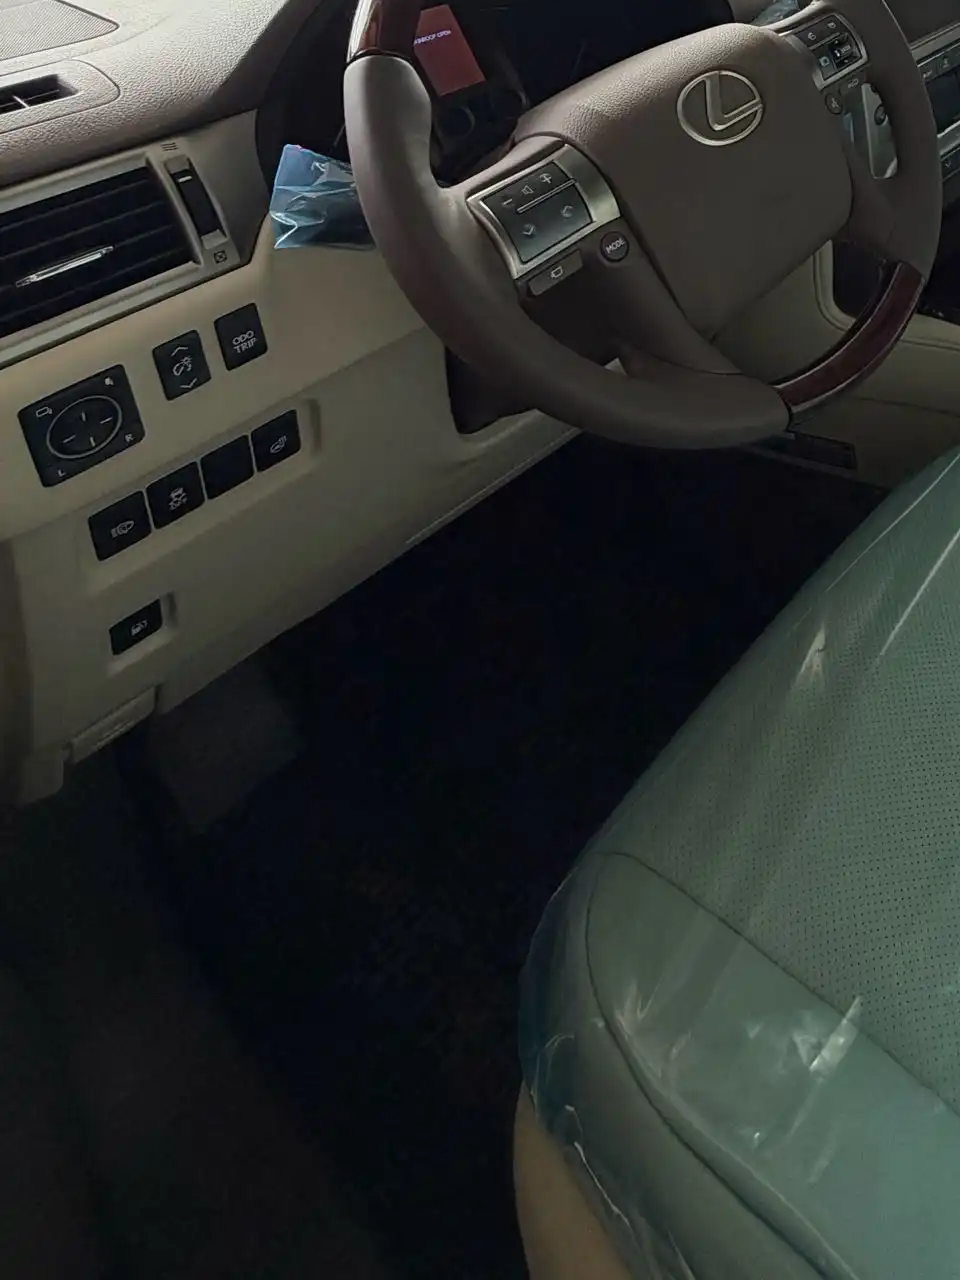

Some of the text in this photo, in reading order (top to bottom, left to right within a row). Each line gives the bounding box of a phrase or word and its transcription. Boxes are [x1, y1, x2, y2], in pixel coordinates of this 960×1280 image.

[605, 237, 626, 254] MODE
[232, 330, 255, 345] ODO
[232, 337, 257, 354] TRIP
[125, 433, 136, 443] R
[57, 468, 68, 478] L
